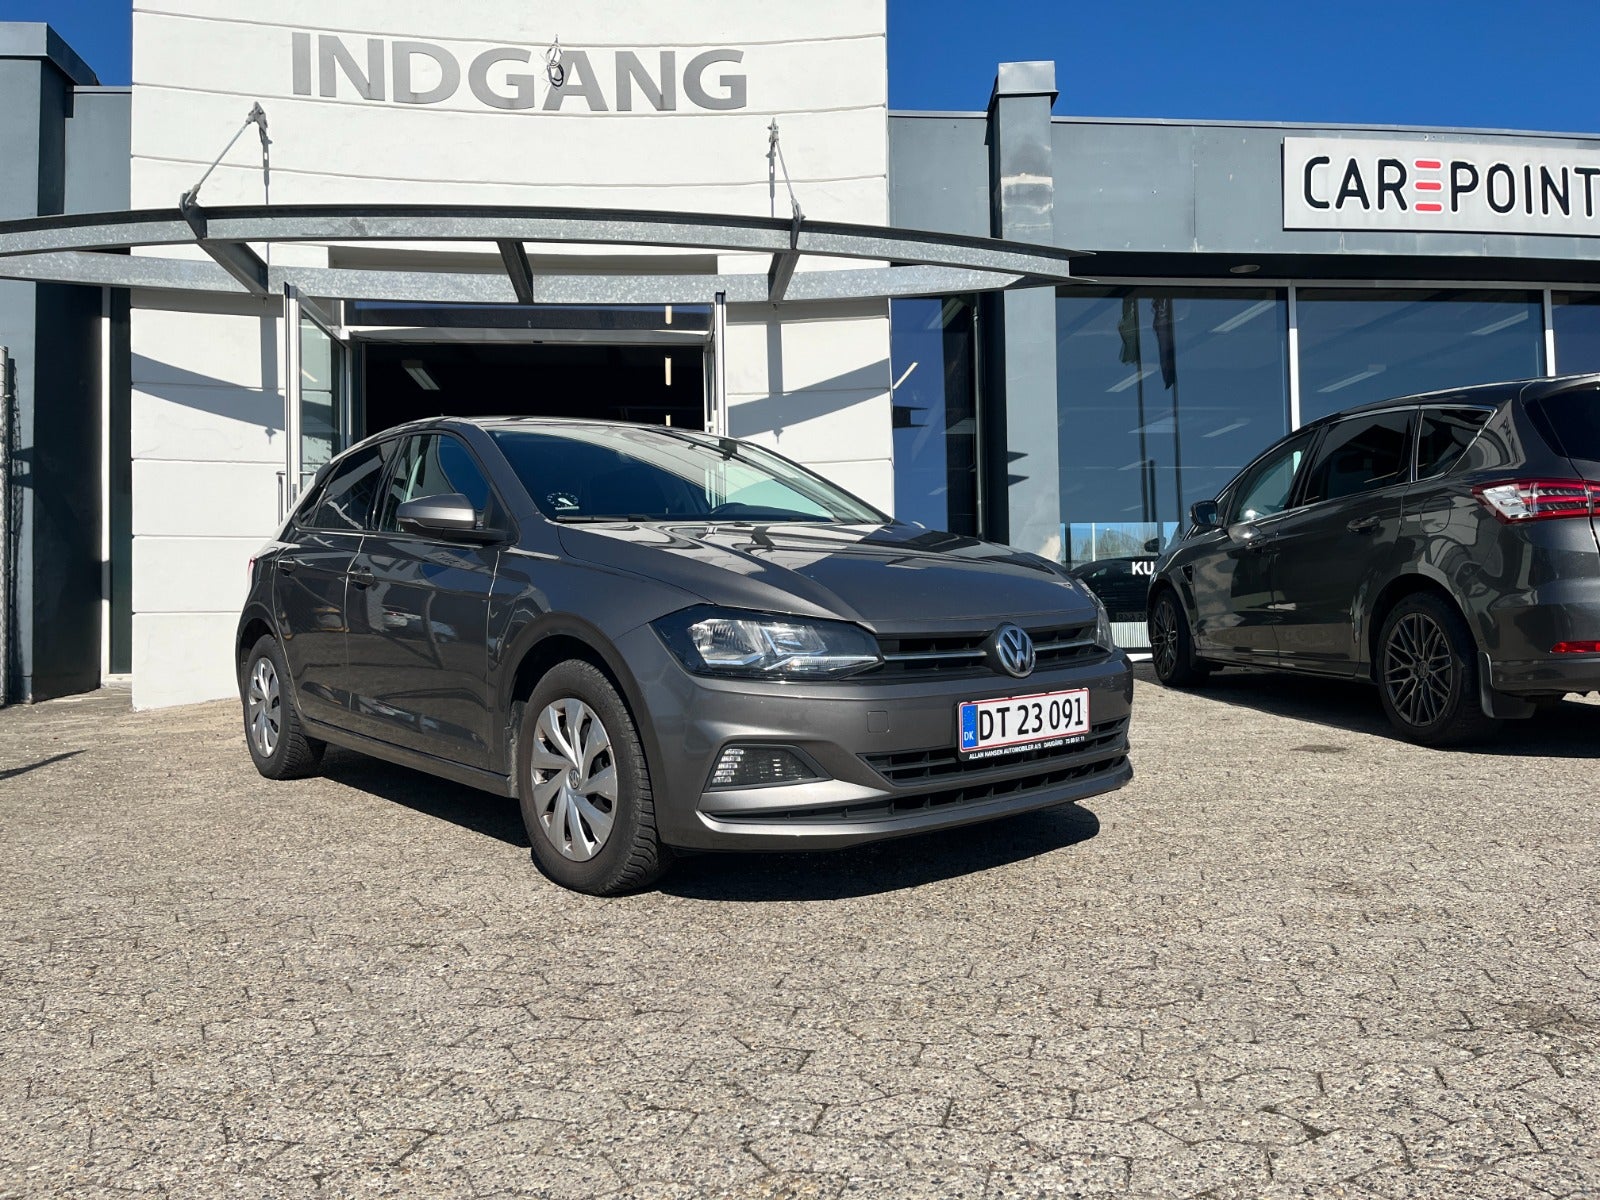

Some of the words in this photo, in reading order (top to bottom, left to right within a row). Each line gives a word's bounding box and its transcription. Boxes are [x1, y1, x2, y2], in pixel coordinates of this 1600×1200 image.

[292, 31, 747, 112] INDGANG
[1131, 561, 1155, 576] KU
[979, 706, 1010, 741] DT
[1017, 703, 1043, 735] 23
[1049, 697, 1084, 730] 091
[963, 731, 974, 741] DK
[969, 751, 984, 760] ALLAN
[984, 748, 1003, 758] HANSEN
[1003, 743, 1034, 755] AUTOMOBILER
